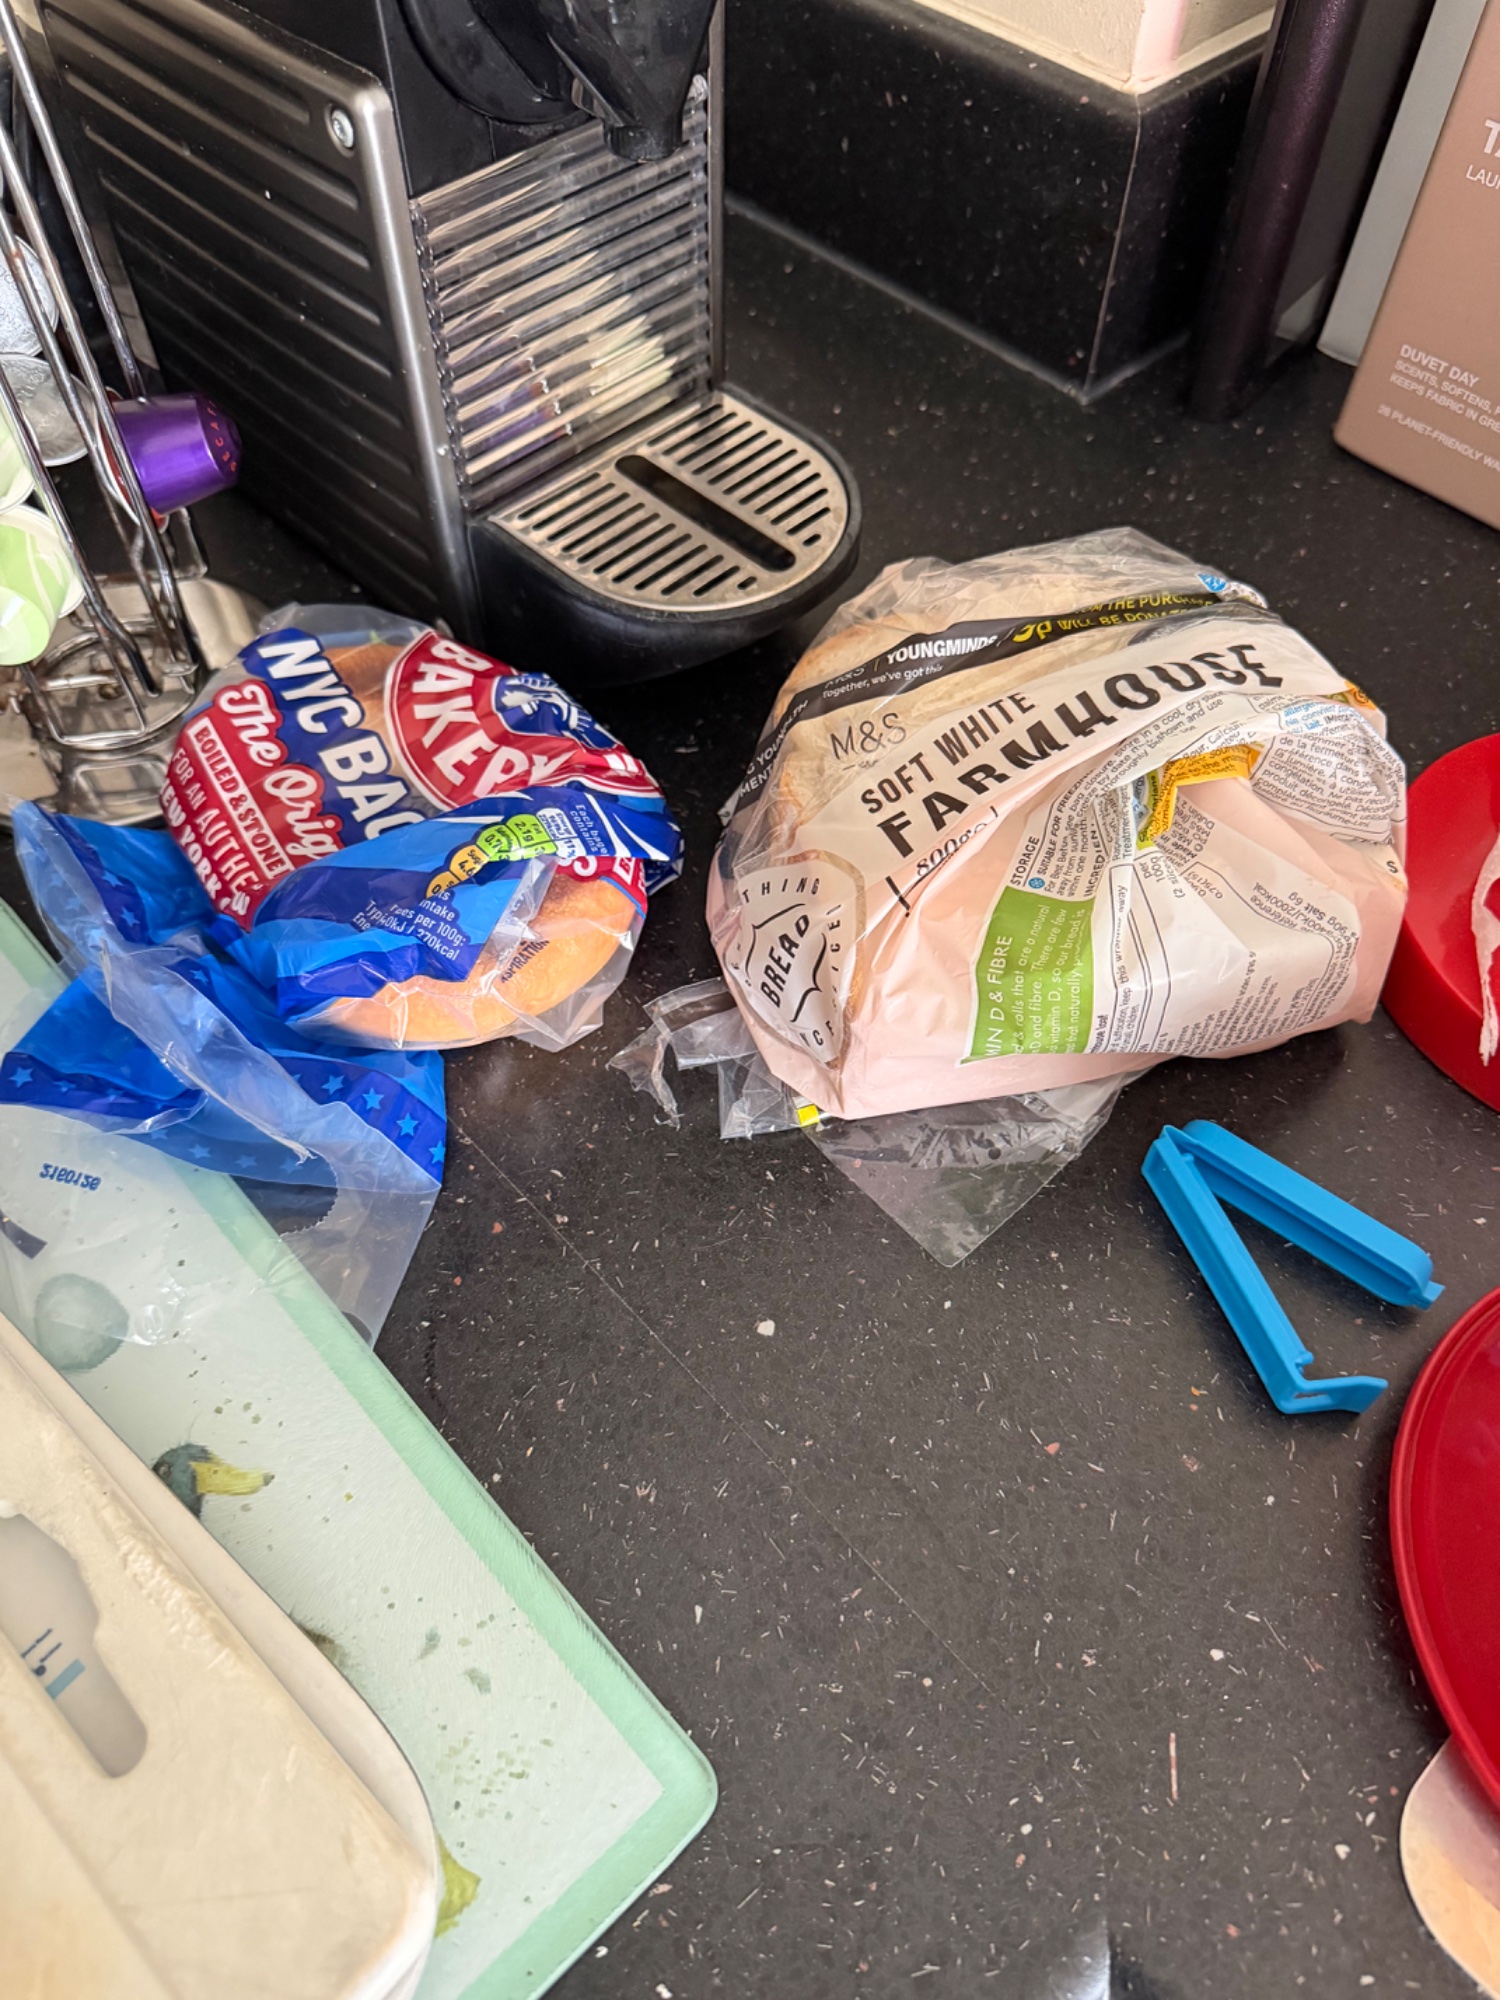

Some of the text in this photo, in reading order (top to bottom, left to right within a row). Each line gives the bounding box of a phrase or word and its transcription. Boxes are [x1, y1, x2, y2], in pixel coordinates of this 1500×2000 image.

[1400, 344, 1480, 388] DUVET DAY
[1390, 373, 1425, 396] KEEPS
[1425, 389, 1465, 415] FABRIC
[1465, 408, 1479, 421] IN
[1440, 381, 1492, 413] SOFTENS,
[1099, 614, 1122, 626] BE
[886, 635, 998, 665] YOUNGMINDS
[257, 639, 362, 734] NYC
[903, 667, 924, 681] got
[218, 684, 281, 767] The
[411, 638, 577, 799] BAKERY
[829, 712, 907, 760] M&S
[1097, 774, 1110, 786] by
[1110, 754, 1132, 773] date
[1186, 709, 1206, 723] and
[1206, 698, 1225, 712] use
[1279, 736, 1294, 746] de
[1297, 739, 1308, 749] la
[194, 726, 240, 793] BOILED
[860, 692, 1036, 815] SOFT WHITE
[876, 644, 1284, 859] FARMHOUSE
[173, 748, 195, 786] FOR
[1261, 768, 1299, 792] produit
[186, 783, 207, 810] AN
[1044, 880, 1056, 893] For
[1069, 792, 1085, 812] bag
[1083, 759, 1117, 791] closure.
[1161, 707, 1185, 726] cool,
[1185, 699, 1202, 711] dry
[513, 820, 535, 842] 2.1g
[570, 811, 599, 852] contains
[576, 805, 594, 828] Each
[1188, 805, 1215, 830] Dublin
[196, 808, 263, 893] AUTHE
[1037, 815, 1062, 876] SUITABLE FOR
[1171, 829, 1193, 846] M&S
[1171, 841, 1198, 859] Made
[1192, 832, 1208, 845] PO
[179, 825, 222, 900] YORK
[1010, 836, 1040, 886] STORAGE
[1063, 855, 1077, 878] from
[1076, 855, 1088, 874] one
[1083, 823, 1106, 898] INGREDIEN
[1140, 862, 1153, 880] per
[742, 877, 820, 904] THING
[419, 899, 456, 922] intake
[1030, 904, 1051, 937] natural
[1051, 908, 1068, 927] few
[1287, 891, 1349, 934] 90g Salt 6g
[414, 914, 437, 929] per
[436, 921, 467, 947] 100g:
[416, 928, 460, 961] 270kcal
[1047, 928, 1061, 944] are
[1065, 914, 1082, 950] bread
[760, 914, 810, 1009] BREAD
[987, 935, 1013, 985] FIBRE
[1018, 947, 1032, 967] are
[1031, 945, 1053, 972] There
[1056, 945, 1069, 967] our
[1011, 970, 1025, 997] that
[1052, 967, 1062, 983] so
[1115, 964, 1130, 985] this
[989, 990, 1004, 1003] &
[1028, 976, 1043, 1012] fibre.
[1047, 986, 1063, 1001] D,
[1066, 970, 1084, 1023] naturally
[990, 1008, 1005, 1021] D
[1012, 1001, 1025, 1027] rolls
[1029, 1015, 1043, 1039] and
[1048, 1005, 1062, 1043] vitamin
